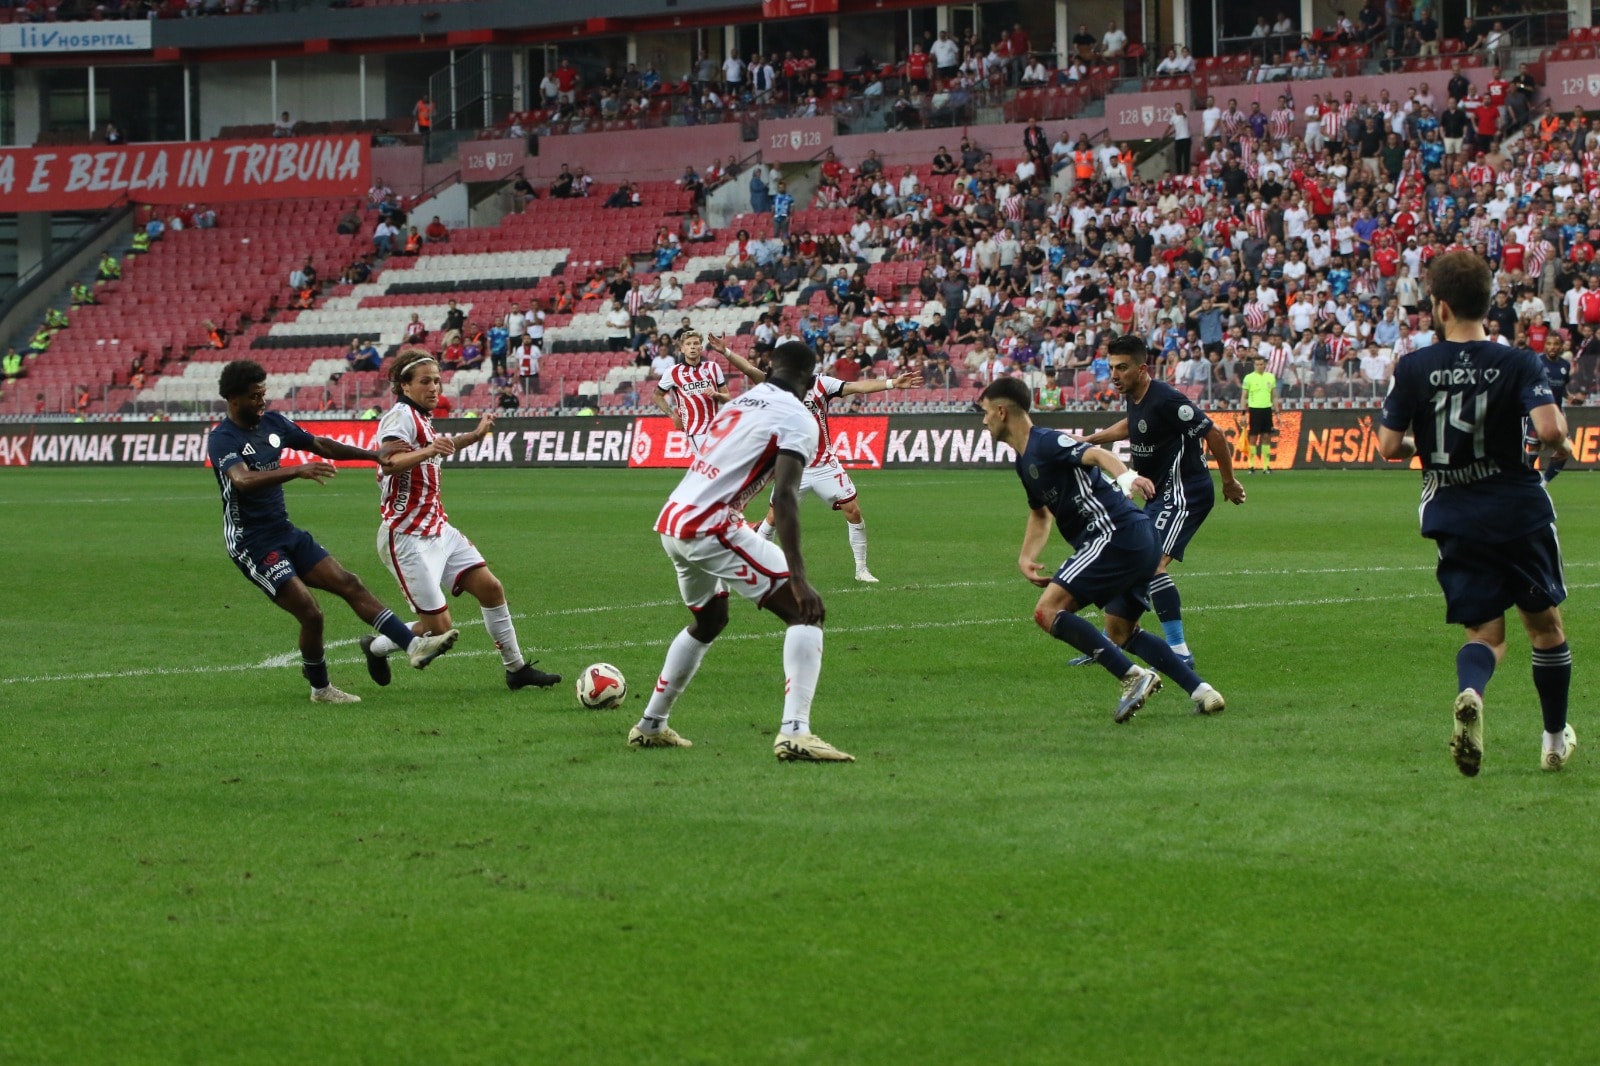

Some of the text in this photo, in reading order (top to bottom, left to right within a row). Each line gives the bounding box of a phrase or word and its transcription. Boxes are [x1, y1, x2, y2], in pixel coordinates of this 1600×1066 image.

[58, 34, 135, 47] HOSPITAL
[1562, 78, 1585, 96] 129
[1119, 109, 1139, 125] 128
[771, 131, 821, 149] 127 128
[0, 138, 361, 195] A E BELLA IN TRIBUNA
[682, 380, 713, 392] COREX
[1429, 390, 1488, 465] 14
[30, 434, 117, 462] KAYNAK
[522, 423, 633, 462] TELLERİ
